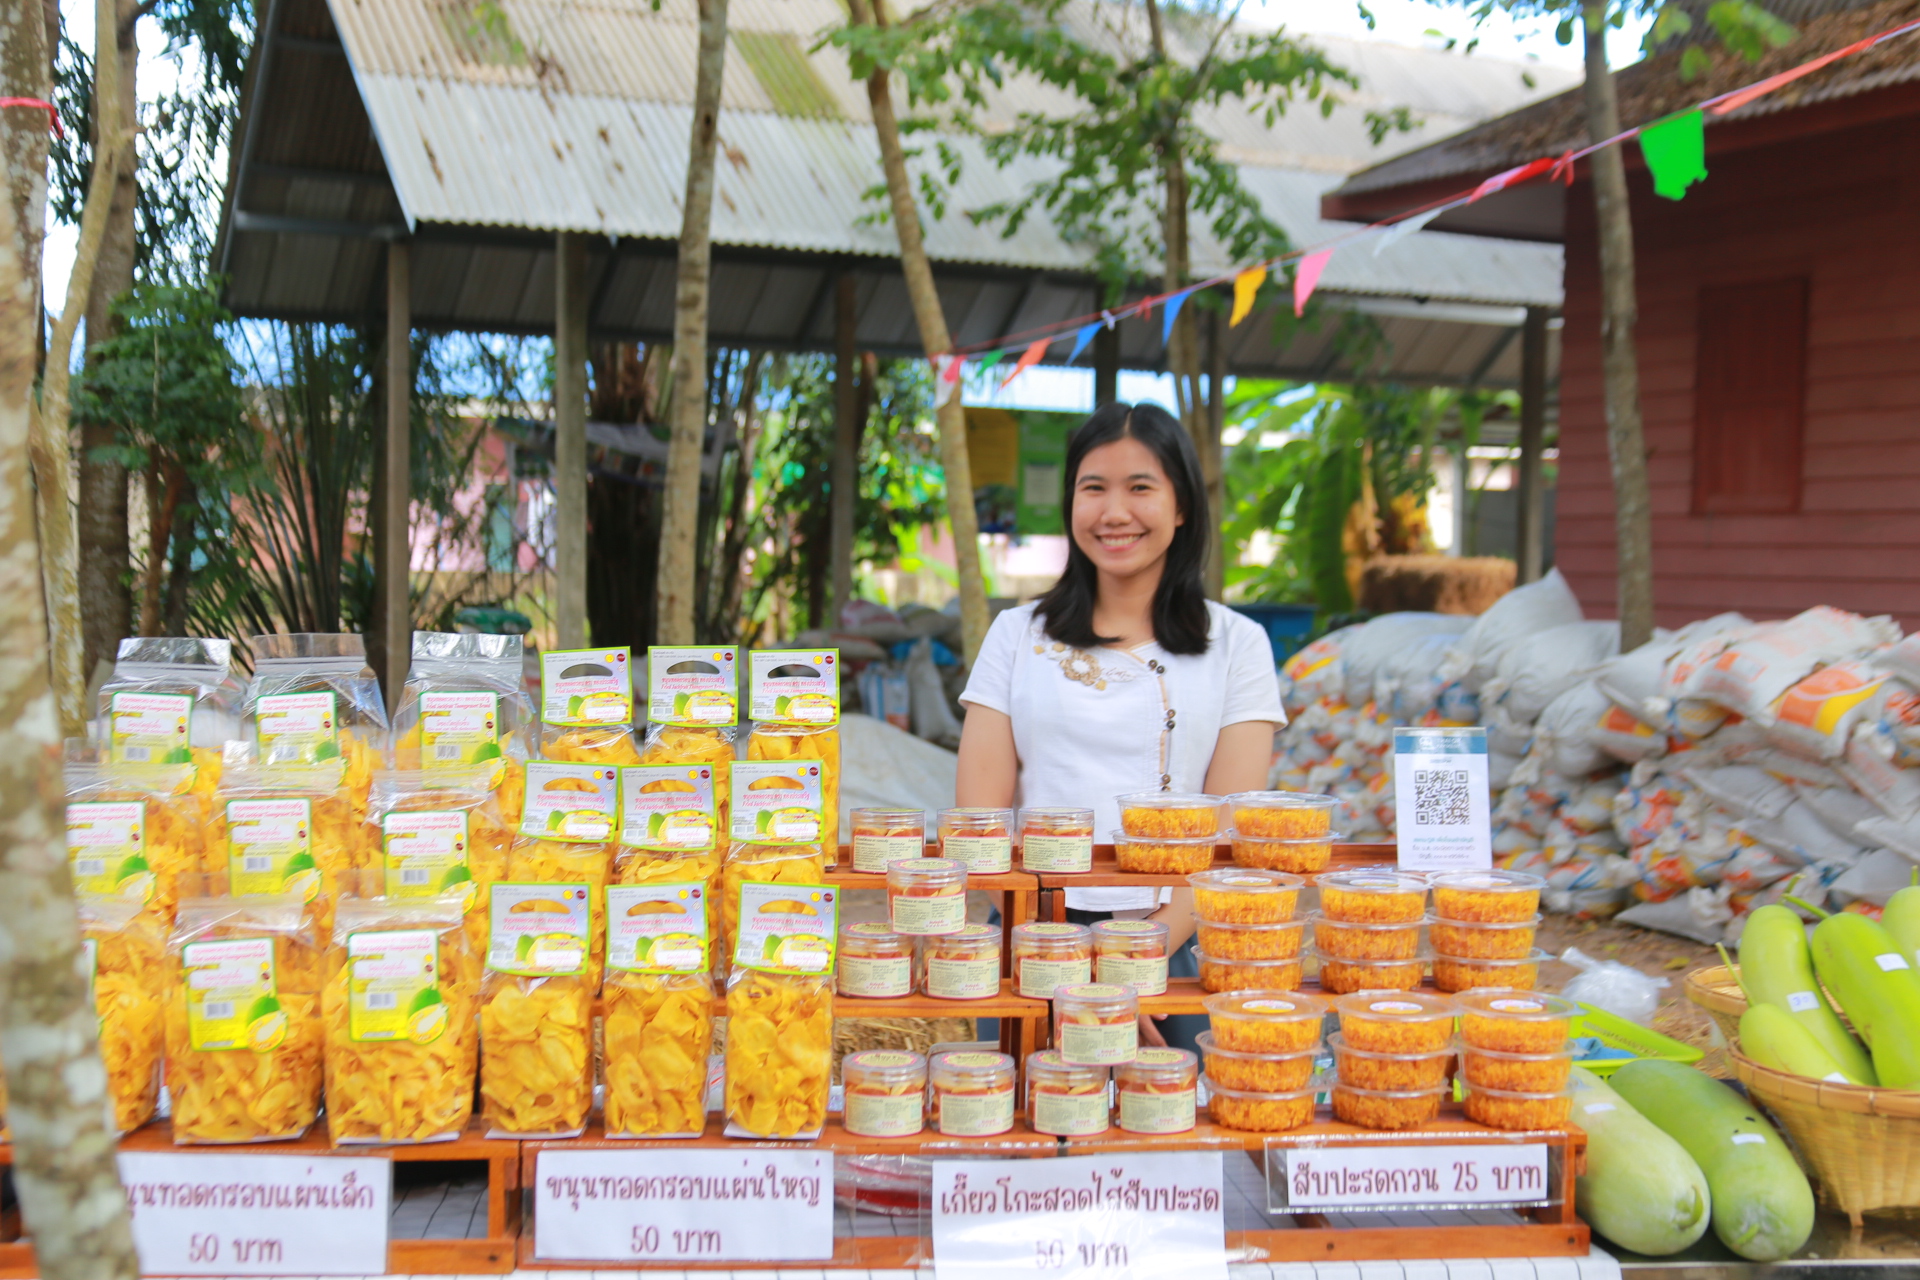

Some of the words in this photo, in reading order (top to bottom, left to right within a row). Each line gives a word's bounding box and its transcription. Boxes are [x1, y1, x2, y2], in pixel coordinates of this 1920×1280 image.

[124, 1166, 374, 1219] นุนทอดกรอบแผ่นเล็ก
[546, 1159, 820, 1212] ขนุนทอดกรอบแผ่นใหญ่
[942, 1168, 1219, 1214] เกี๊ยวโกะสอดไส้สับปะรด
[1294, 1161, 1439, 1196] สับปะรดกวน
[1453, 1161, 1478, 1192] 25
[1492, 1164, 1541, 1191] บาท
[189, 1233, 219, 1263] 50
[233, 1236, 283, 1263] บาท
[631, 1225, 660, 1254] 50
[673, 1229, 721, 1254] บาท
[1036, 1239, 1064, 1269] 50
[1077, 1243, 1128, 1268] บาท
